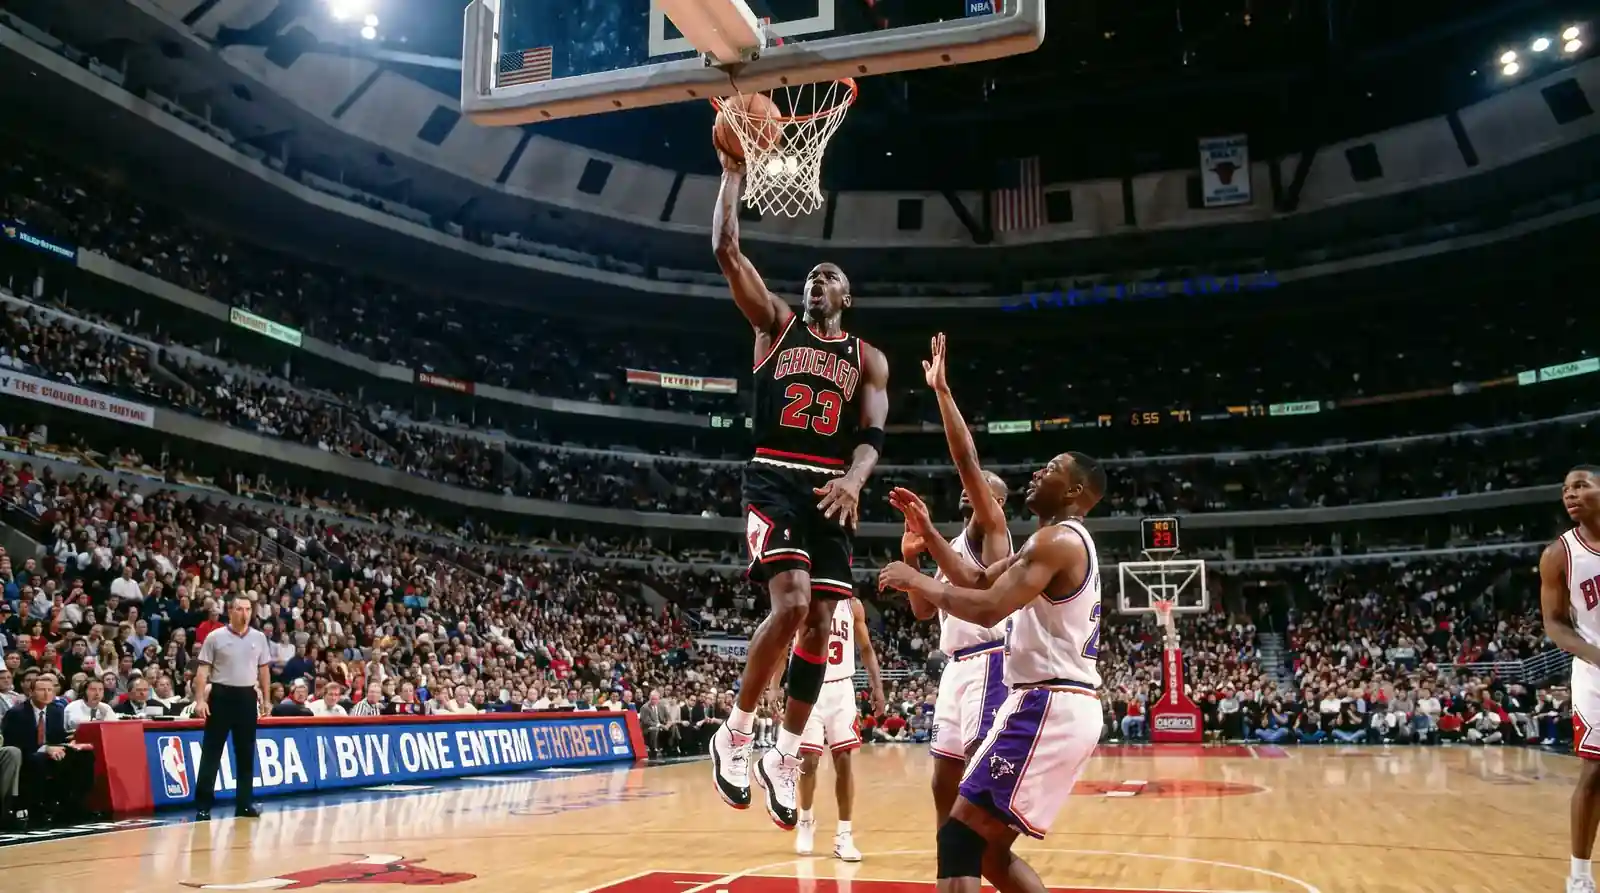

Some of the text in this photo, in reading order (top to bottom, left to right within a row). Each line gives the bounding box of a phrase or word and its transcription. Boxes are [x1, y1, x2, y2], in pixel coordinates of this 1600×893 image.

[970, 3, 990, 13] NBA
[774, 347, 859, 402] CHICAGO
[780, 383, 843, 436] 23
[829, 617, 849, 641] LS
[400, 732, 454, 773] ONE
[455, 728, 533, 768] ENTRM
